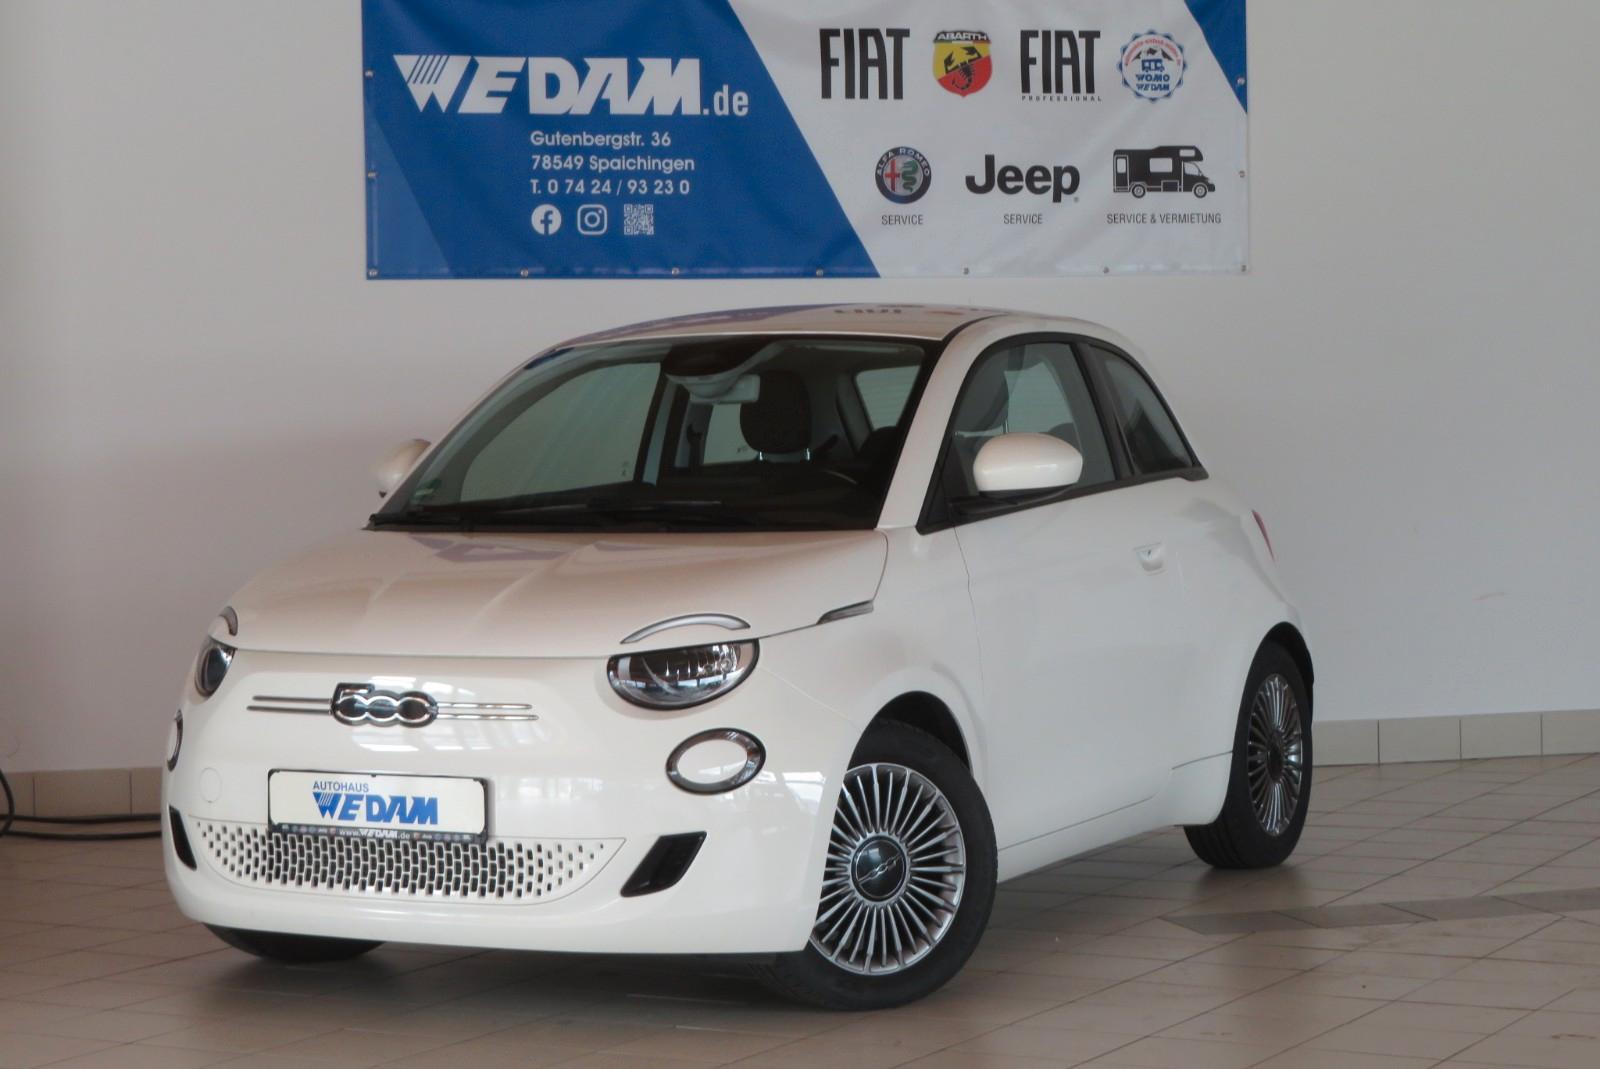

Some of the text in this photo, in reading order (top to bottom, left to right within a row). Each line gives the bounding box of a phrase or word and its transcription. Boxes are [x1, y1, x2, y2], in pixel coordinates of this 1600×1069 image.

[937, 32, 988, 41] ABARTH
[819, 28, 910, 100] FIAT
[1020, 30, 1101, 94] FIAT
[1136, 74, 1170, 82] WOMO
[530, 130, 672, 150] Gutenbergstr. 36
[531, 155, 695, 174] 78549 Spaichingen
[877, 148, 930, 176] ALFA ROMEO
[530, 179, 542, 194] T.
[547, 179, 559, 194] 0
[565, 179, 585, 194] 74
[591, 179, 612, 194] 24
[627, 179, 648, 194] 93
[653, 179, 674, 194] 23
[679, 179, 690, 194] 0
[965, 154, 1080, 203] Jeep
[881, 214, 924, 226] SERVICE
[1003, 214, 1043, 225] SERVICE
[1106, 212, 1222, 225] SERVICE & VERMIETUNG
[312, 780, 369, 794] AUTOHAUS
[312, 791, 438, 825] WEDAM
